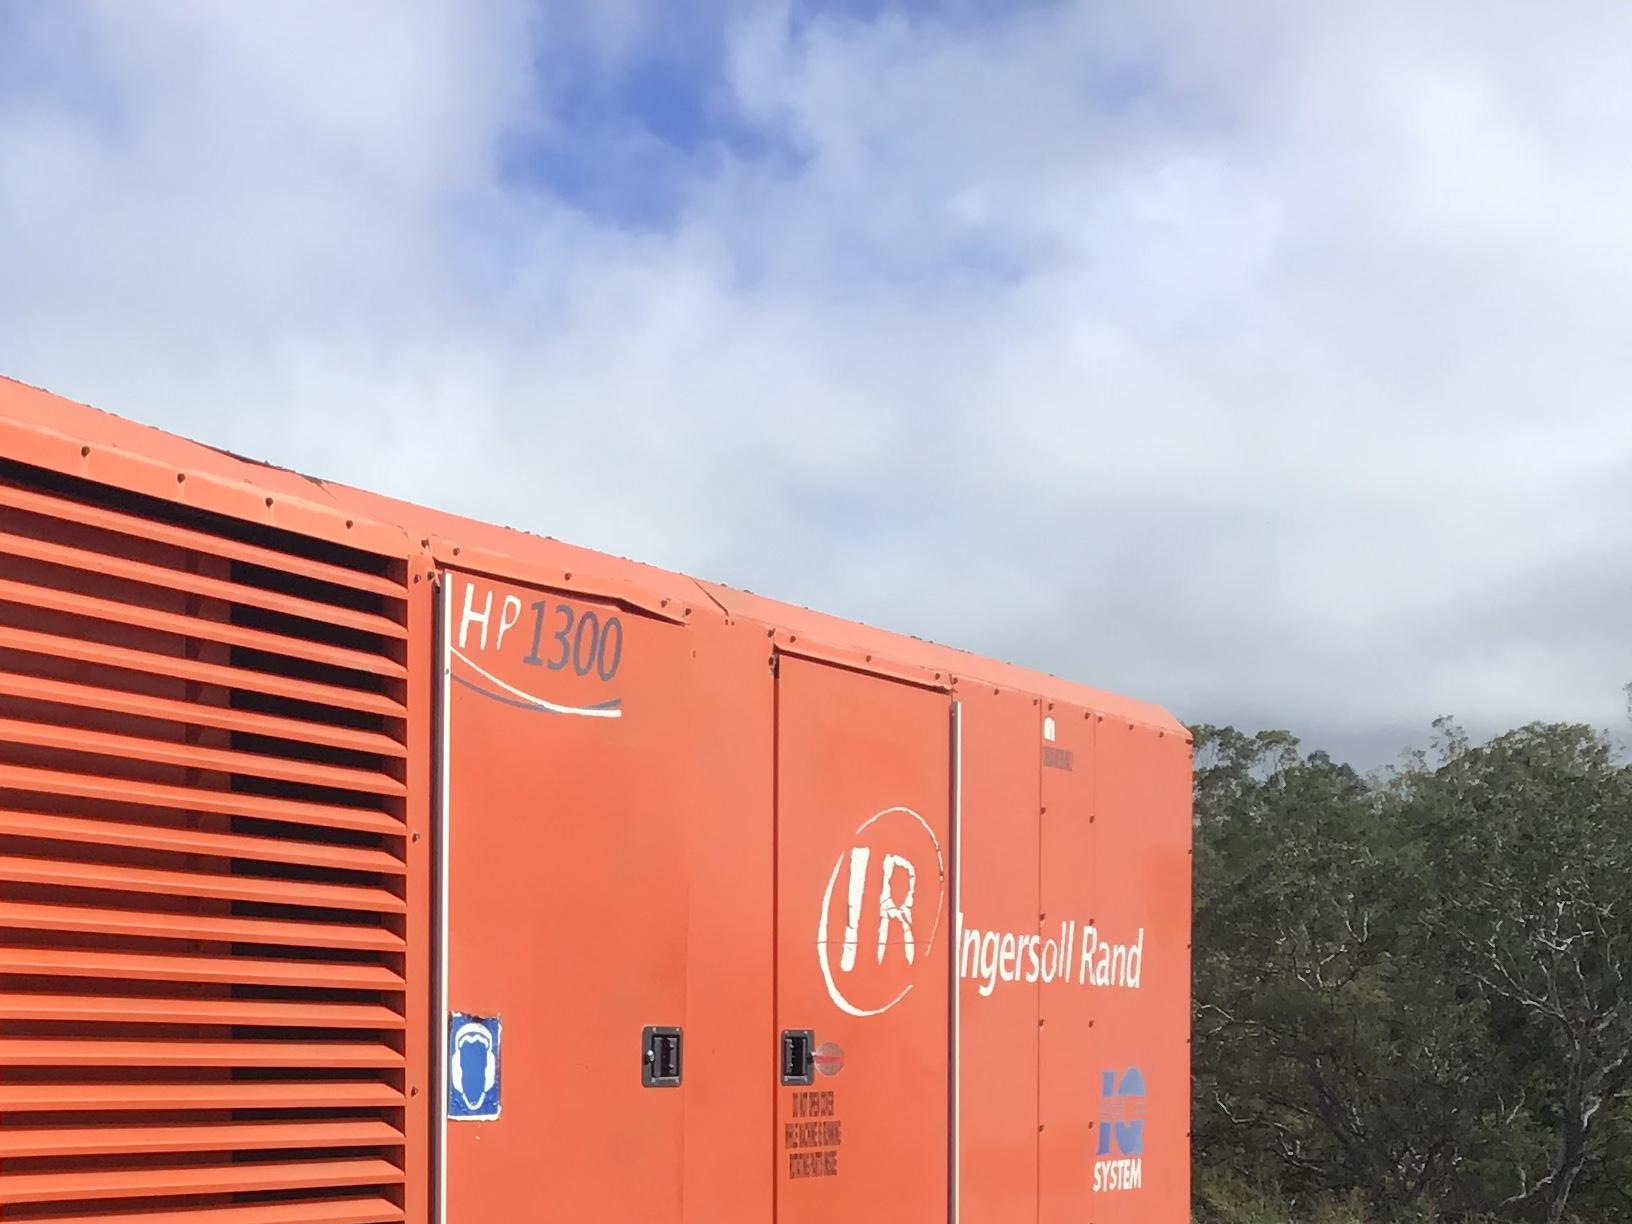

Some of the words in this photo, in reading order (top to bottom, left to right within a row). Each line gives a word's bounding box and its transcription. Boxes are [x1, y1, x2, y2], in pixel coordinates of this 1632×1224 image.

[957, 911, 1075, 996] Ingersoll
[1079, 925, 1145, 989] Rand
[1093, 1157, 1142, 1193] SYSTEM
